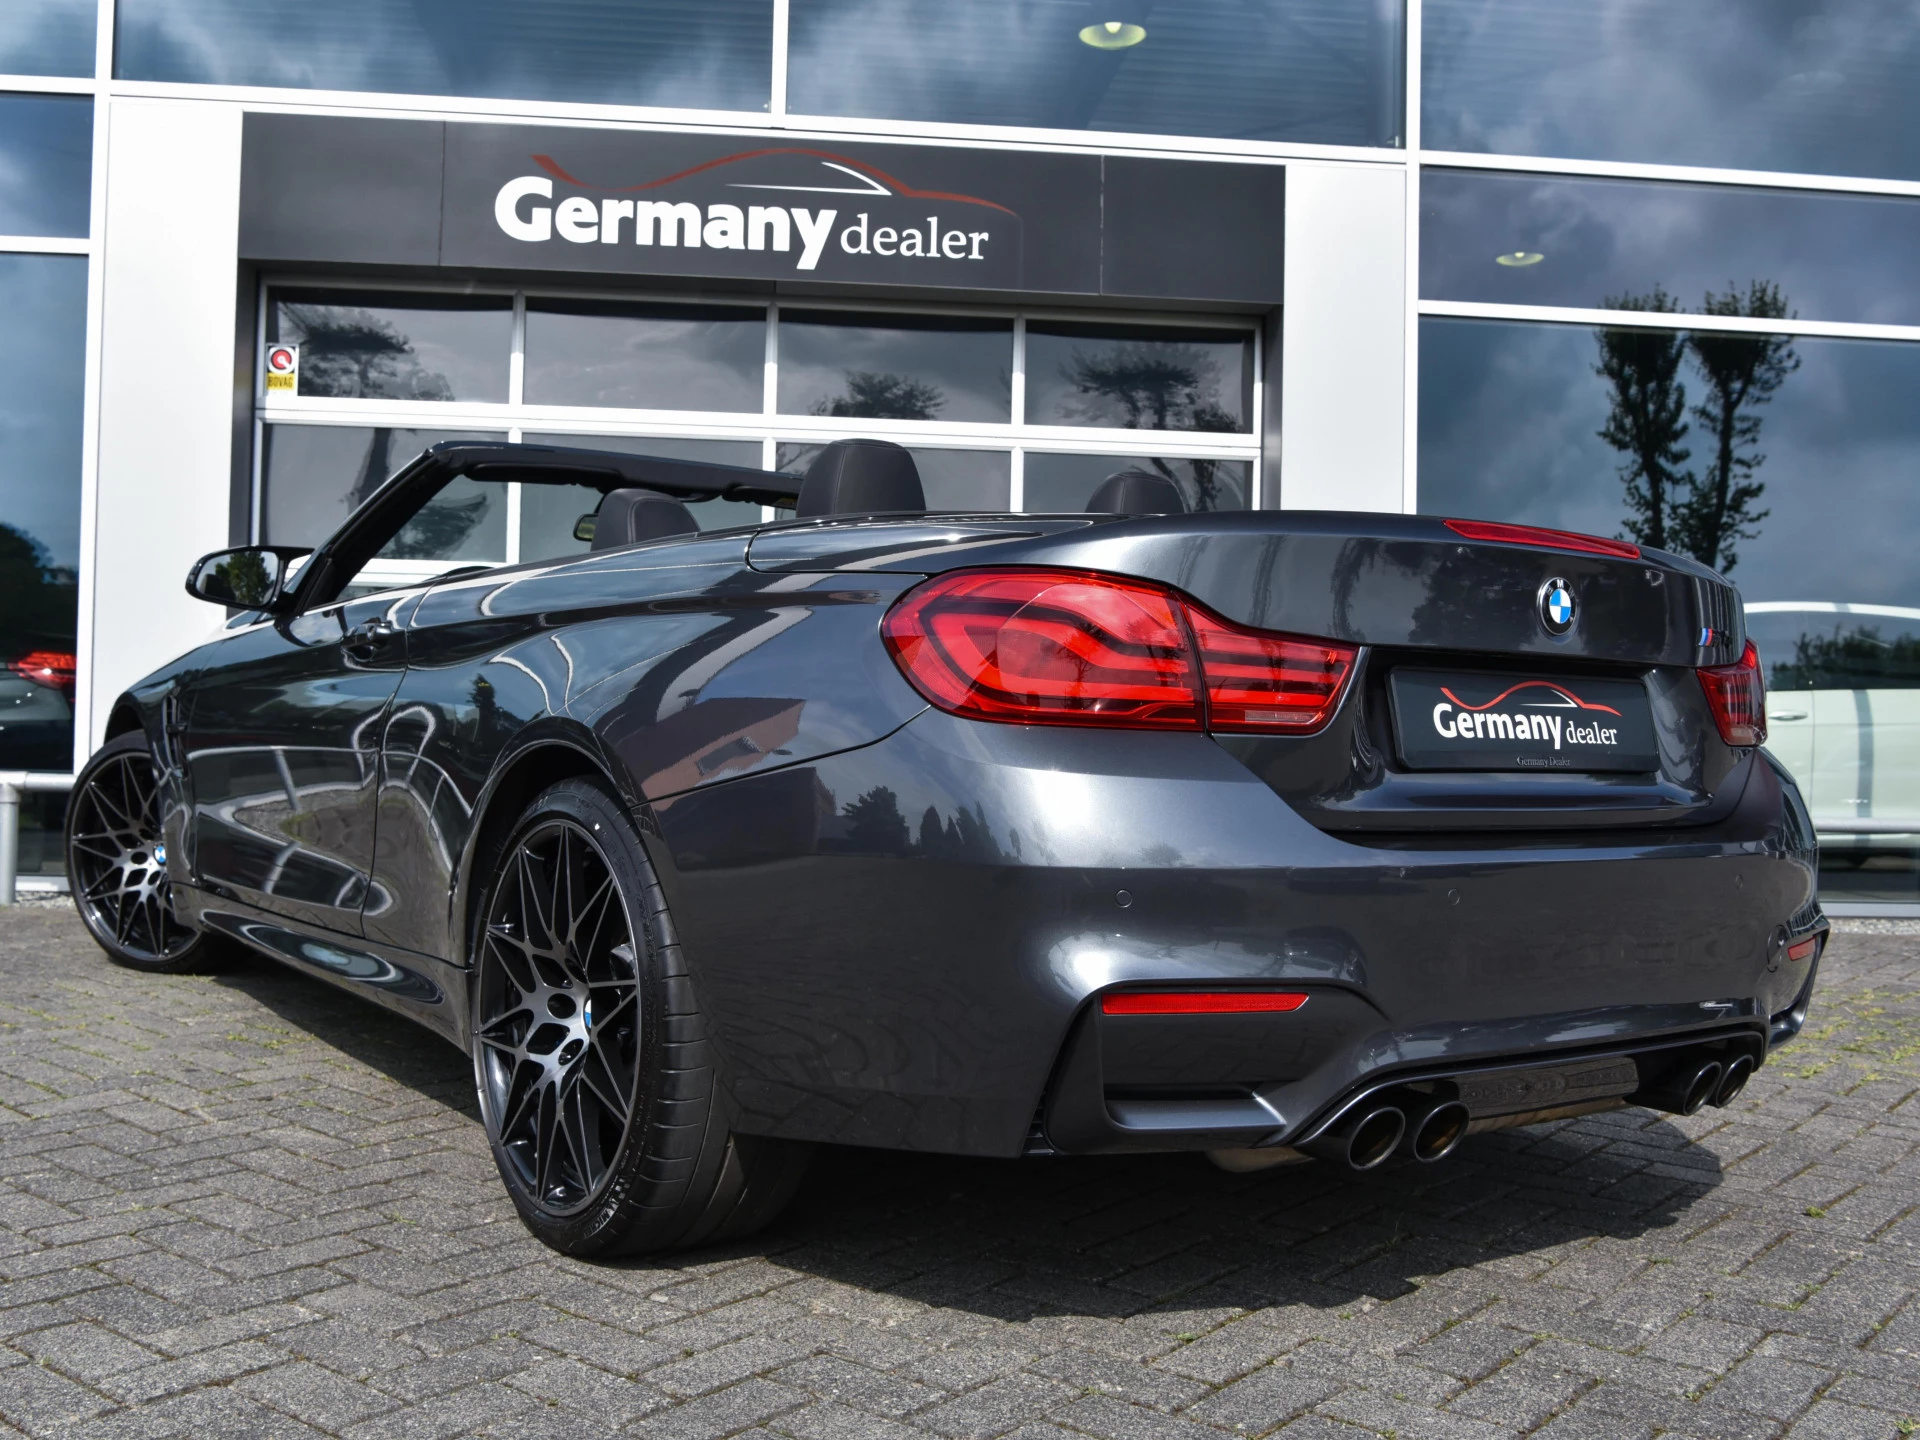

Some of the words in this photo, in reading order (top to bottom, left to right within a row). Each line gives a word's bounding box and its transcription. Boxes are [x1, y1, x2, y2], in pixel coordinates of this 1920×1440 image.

[494, 175, 838, 271] Germany
[840, 212, 990, 260] dealer
[1432, 702, 1562, 750] Germany
[1565, 720, 1618, 745] dealer
[1516, 756, 1548, 767] Germany
[1549, 756, 1571, 766] Dealer
